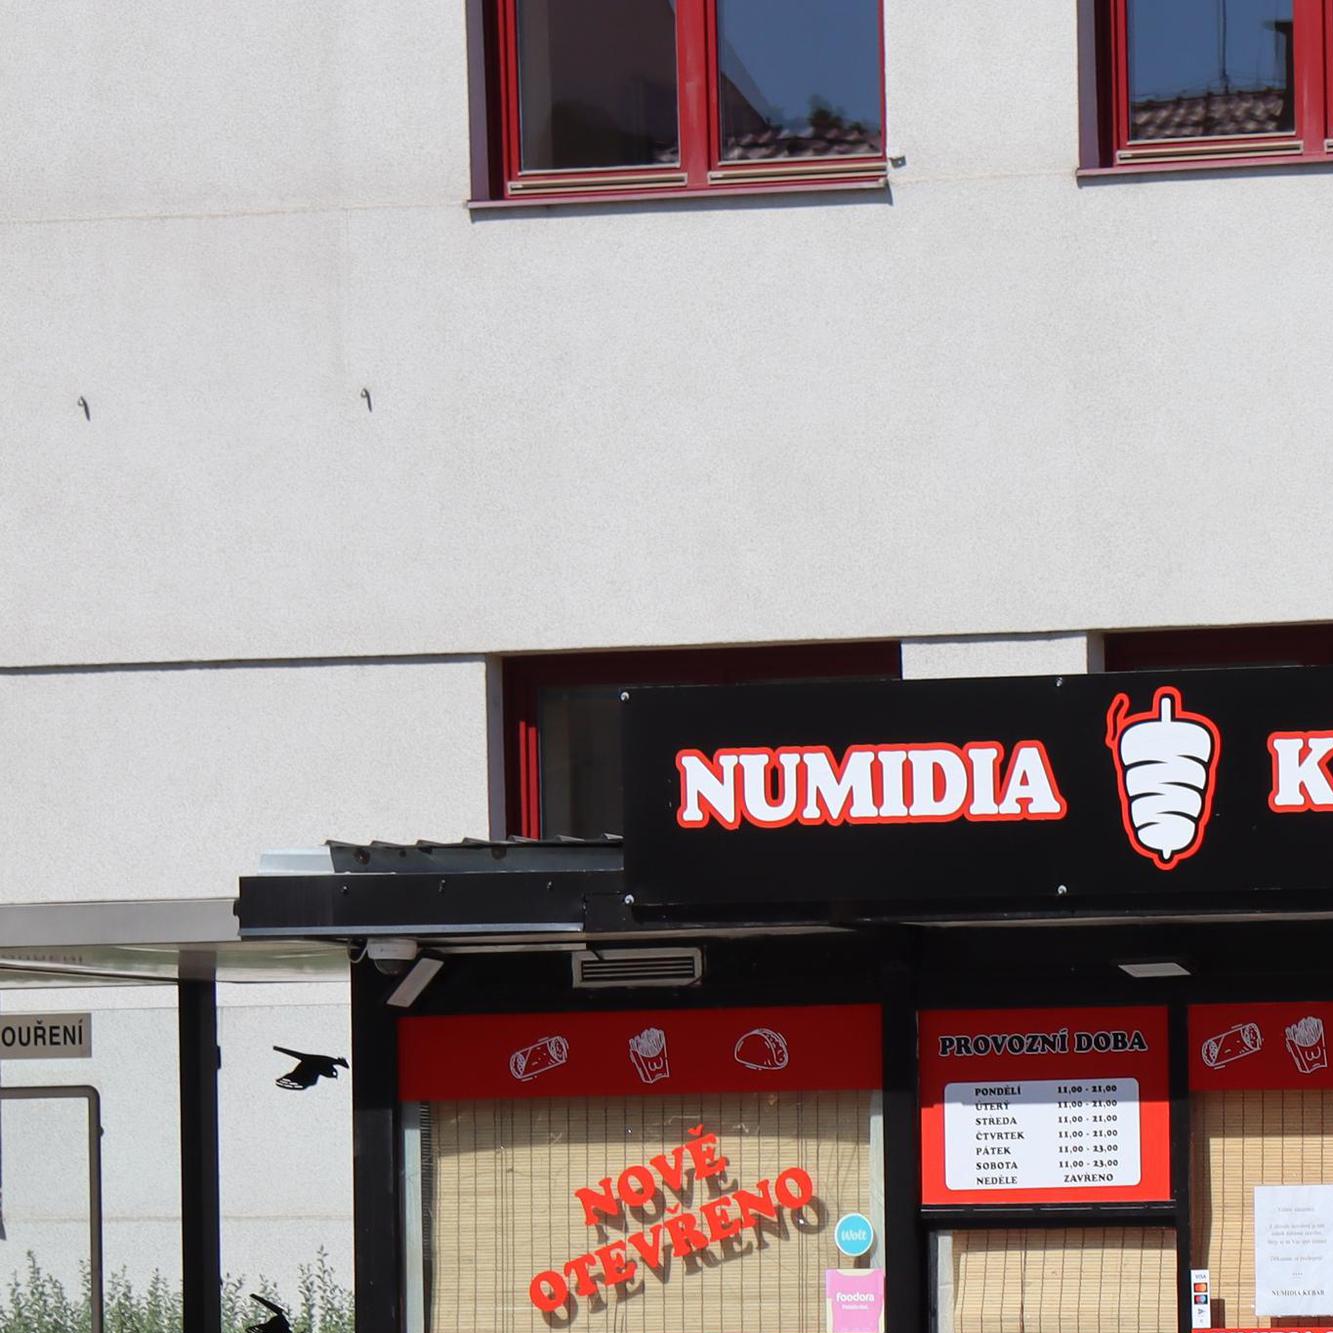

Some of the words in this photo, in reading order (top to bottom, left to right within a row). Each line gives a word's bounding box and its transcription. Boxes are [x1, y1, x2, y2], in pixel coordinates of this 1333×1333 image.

[678, 741, 1067, 829] NUMIDIA
[939, 1028, 1069, 1056] PROVOZNÍ
[1074, 1031, 1149, 1053] DOBA
[974, 1085, 1022, 1096] PONDĚLÍ
[975, 1101, 1010, 1111] ÚTERÝ
[975, 1115, 1018, 1126] STŘEDA
[975, 1130, 1025, 1141] ČTVRTEK
[975, 1145, 1012, 1156] PÁTEK
[975, 1161, 1018, 1170] SOBOTA
[575, 1124, 727, 1227] NOVĚ
[976, 1175, 1018, 1186] NEDĚLE
[1064, 1172, 1114, 1183] ZAVŘENO
[529, 1168, 814, 1313] OTEVŘENO
[836, 1292, 875, 1303] foodora
